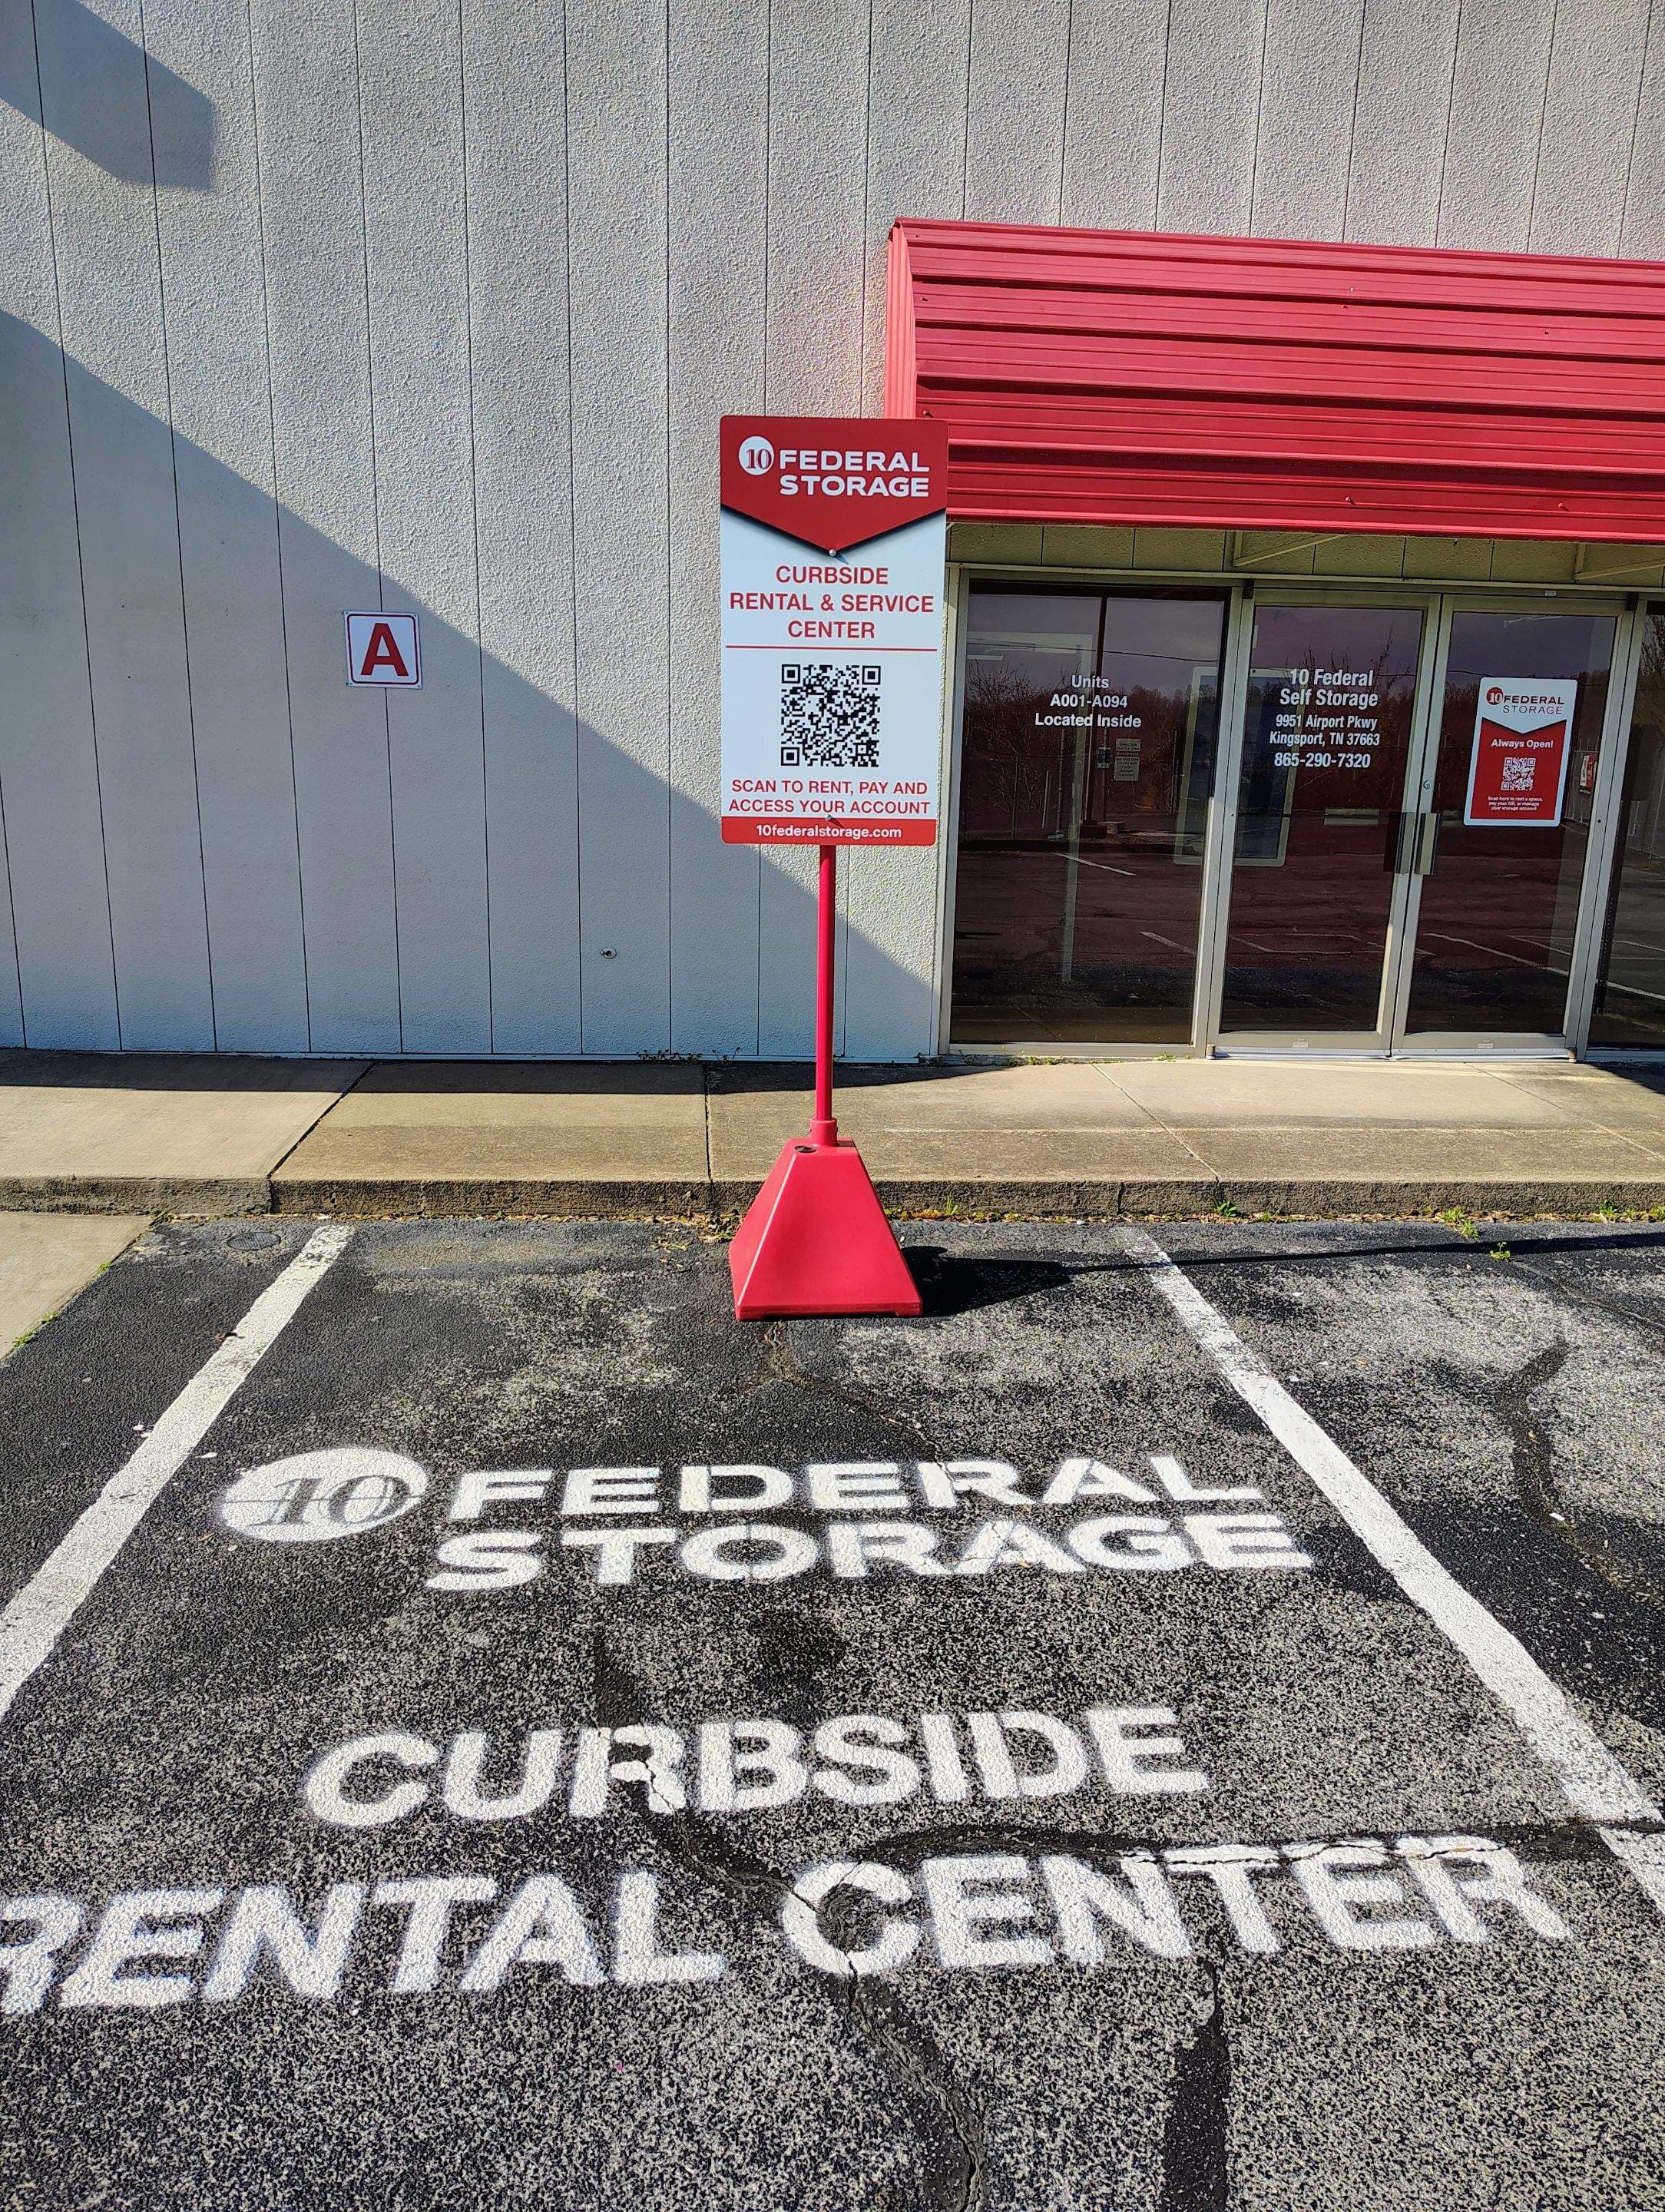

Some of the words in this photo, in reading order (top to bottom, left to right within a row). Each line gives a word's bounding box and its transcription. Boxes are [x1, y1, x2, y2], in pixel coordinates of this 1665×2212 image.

[745, 449, 772, 469] 10
[780, 449, 930, 472] FEDERAL
[780, 475, 929, 497] STORAGE
[776, 565, 889, 585] CURBSIDE
[730, 592, 814, 611] RENTAL
[820, 594, 835, 611] &
[841, 594, 934, 613] SERVICE
[788, 620, 876, 639] CENTER
[360, 622, 409, 677] A
[1071, 674, 1110, 689] Units
[1290, 667, 1309, 685] 10
[1313, 668, 1374, 687] Federal
[1050, 694, 1128, 708] A001-A094
[1279, 688, 1312, 706] Self
[1316, 688, 1379, 710] Storage
[1489, 692, 1503, 704] 10
[1504, 695, 1564, 704] FEDERAL
[1502, 705, 1563, 714] STORAGE
[1034, 712, 1094, 727] Located
[1097, 714, 1142, 728] Inside
[1276, 714, 1302, 727] 9951
[1305, 714, 1345, 730] Airport
[1346, 715, 1378, 731] Pkwy
[1269, 730, 1326, 747] Kingsport,
[1329, 732, 1344, 745] TN
[1346, 733, 1381, 746] 37663
[1491, 738, 1524, 749] Always
[1526, 740, 1554, 750] Open!
[1274, 752, 1371, 769] 865-290-7320
[732, 780, 776, 793] SCAN
[782, 780, 803, 793] TO
[809, 781, 854, 796] RENT,
[859, 782, 889, 794] PAY
[893, 782, 928, 795] AND
[729, 799, 794, 813] ACCESS
[799, 800, 845, 813] YOUR
[849, 801, 931, 814] ACCOUNT
[756, 824, 902, 838] 10federalstorage.com
[448, 1455, 1262, 1518] FEDERAL
[426, 1514, 1313, 1591] STORAGE
[305, 1705, 1208, 1827] CURBSIDE
[781, 1836, 1574, 1976] CENTER
